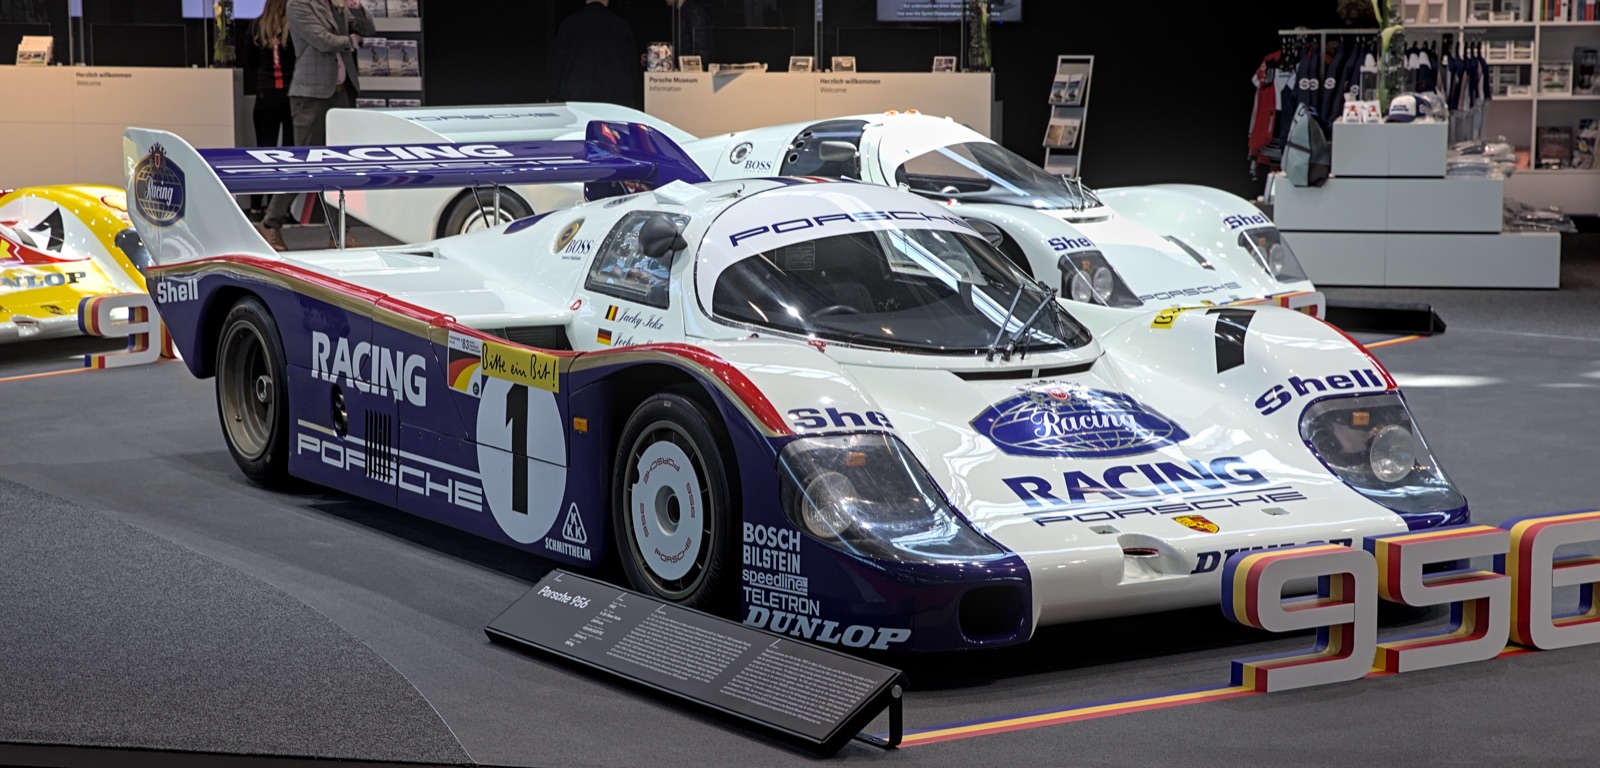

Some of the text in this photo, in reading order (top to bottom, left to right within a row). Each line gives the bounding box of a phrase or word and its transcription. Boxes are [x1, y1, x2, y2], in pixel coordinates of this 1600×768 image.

[819, 86, 847, 94] Welcome
[245, 144, 514, 163] RACING
[744, 159, 773, 170] BOSS
[145, 175, 174, 207] Racing
[729, 211, 976, 248] PORSCHE
[1047, 236, 1096, 251] She
[565, 239, 595, 255] BOSS
[157, 280, 200, 304] Shell
[1140, 281, 1242, 303] PORSCHE
[617, 307, 643, 329] Jacky
[311, 330, 427, 407] RACING
[482, 342, 507, 374] Bitte
[510, 362, 527, 379] ein
[1255, 369, 1384, 416] Shell
[1030, 409, 1137, 439] Racing
[505, 383, 529, 516] 1
[297, 432, 483, 512] PORSCHE
[643, 456, 681, 485] PORSCHE
[1001, 455, 1271, 508] RACING
[1032, 490, 1308, 527] PORSCHE
[544, 536, 592, 562] SCHMITTHELM
[654, 536, 693, 564] PORSCHE
[743, 521, 800, 552] BOSCH
[742, 544, 801, 575] BILSTEIN
[742, 568, 806, 592] speedline
[537, 585, 592, 609] Porsche 956
[742, 586, 820, 617] TELETRON
[1221, 508, 1600, 694] 956
[742, 604, 912, 651] DUNLOP
